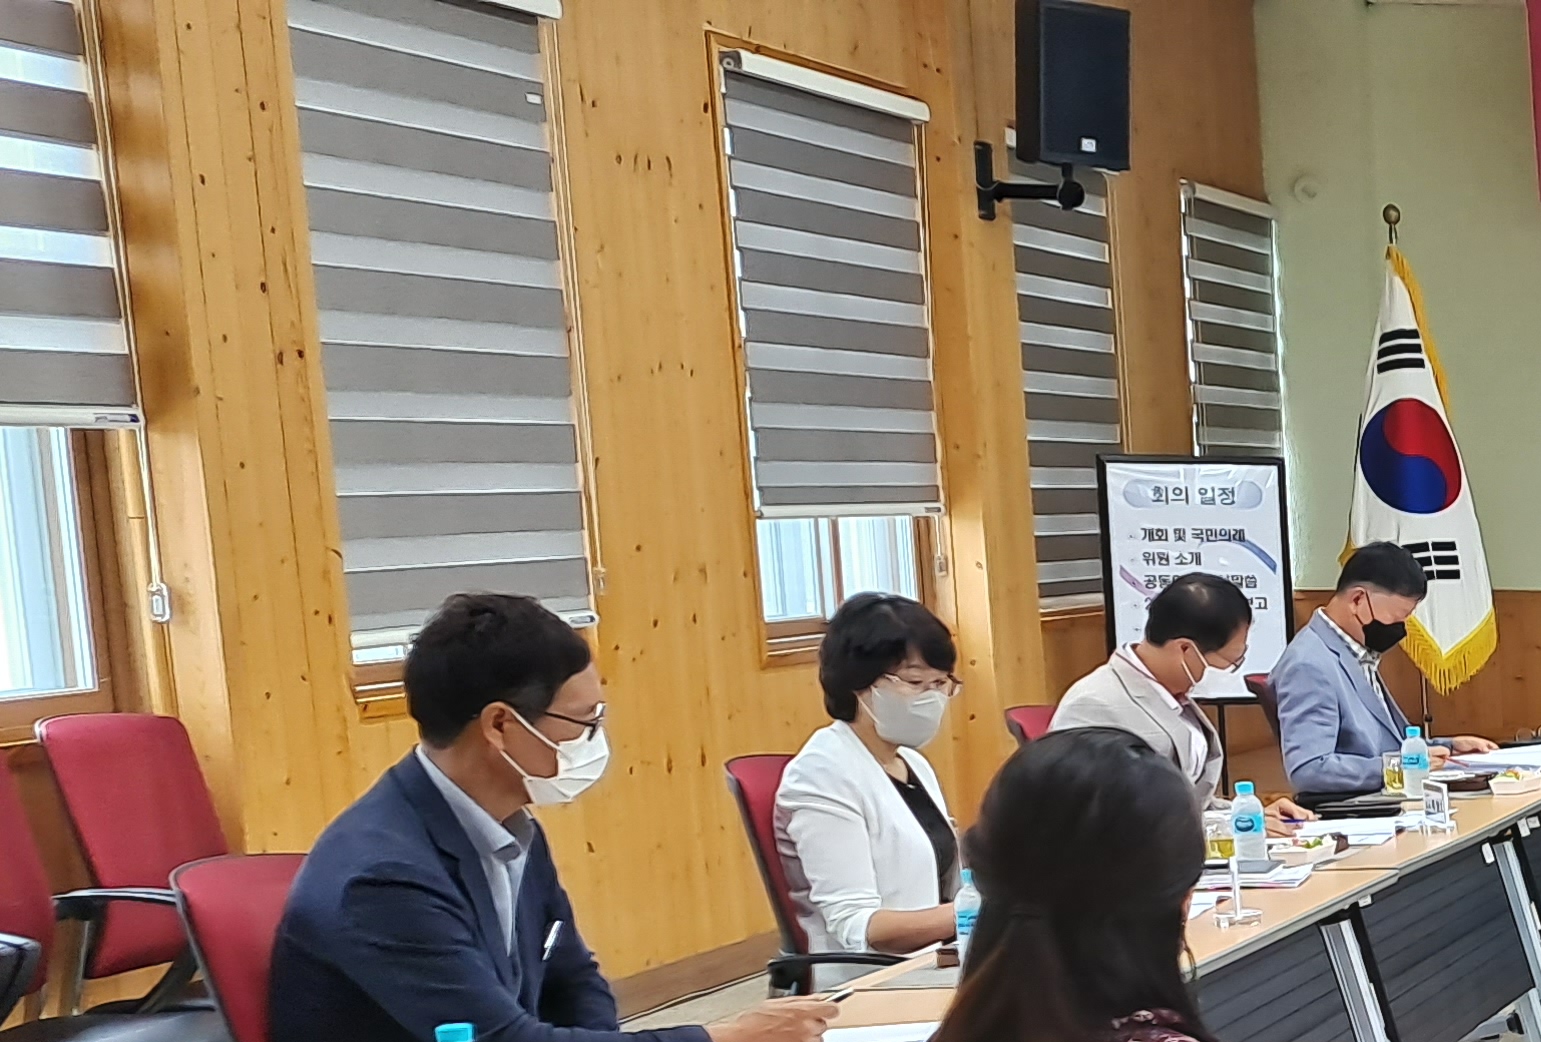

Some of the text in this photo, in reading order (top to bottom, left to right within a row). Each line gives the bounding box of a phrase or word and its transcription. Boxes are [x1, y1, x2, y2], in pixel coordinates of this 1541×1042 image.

[1152, 485, 1237, 506] 회의 일정
[1141, 527, 1246, 542] 개회 및 국민의례
[1142, 552, 1202, 566] 위원 소개
